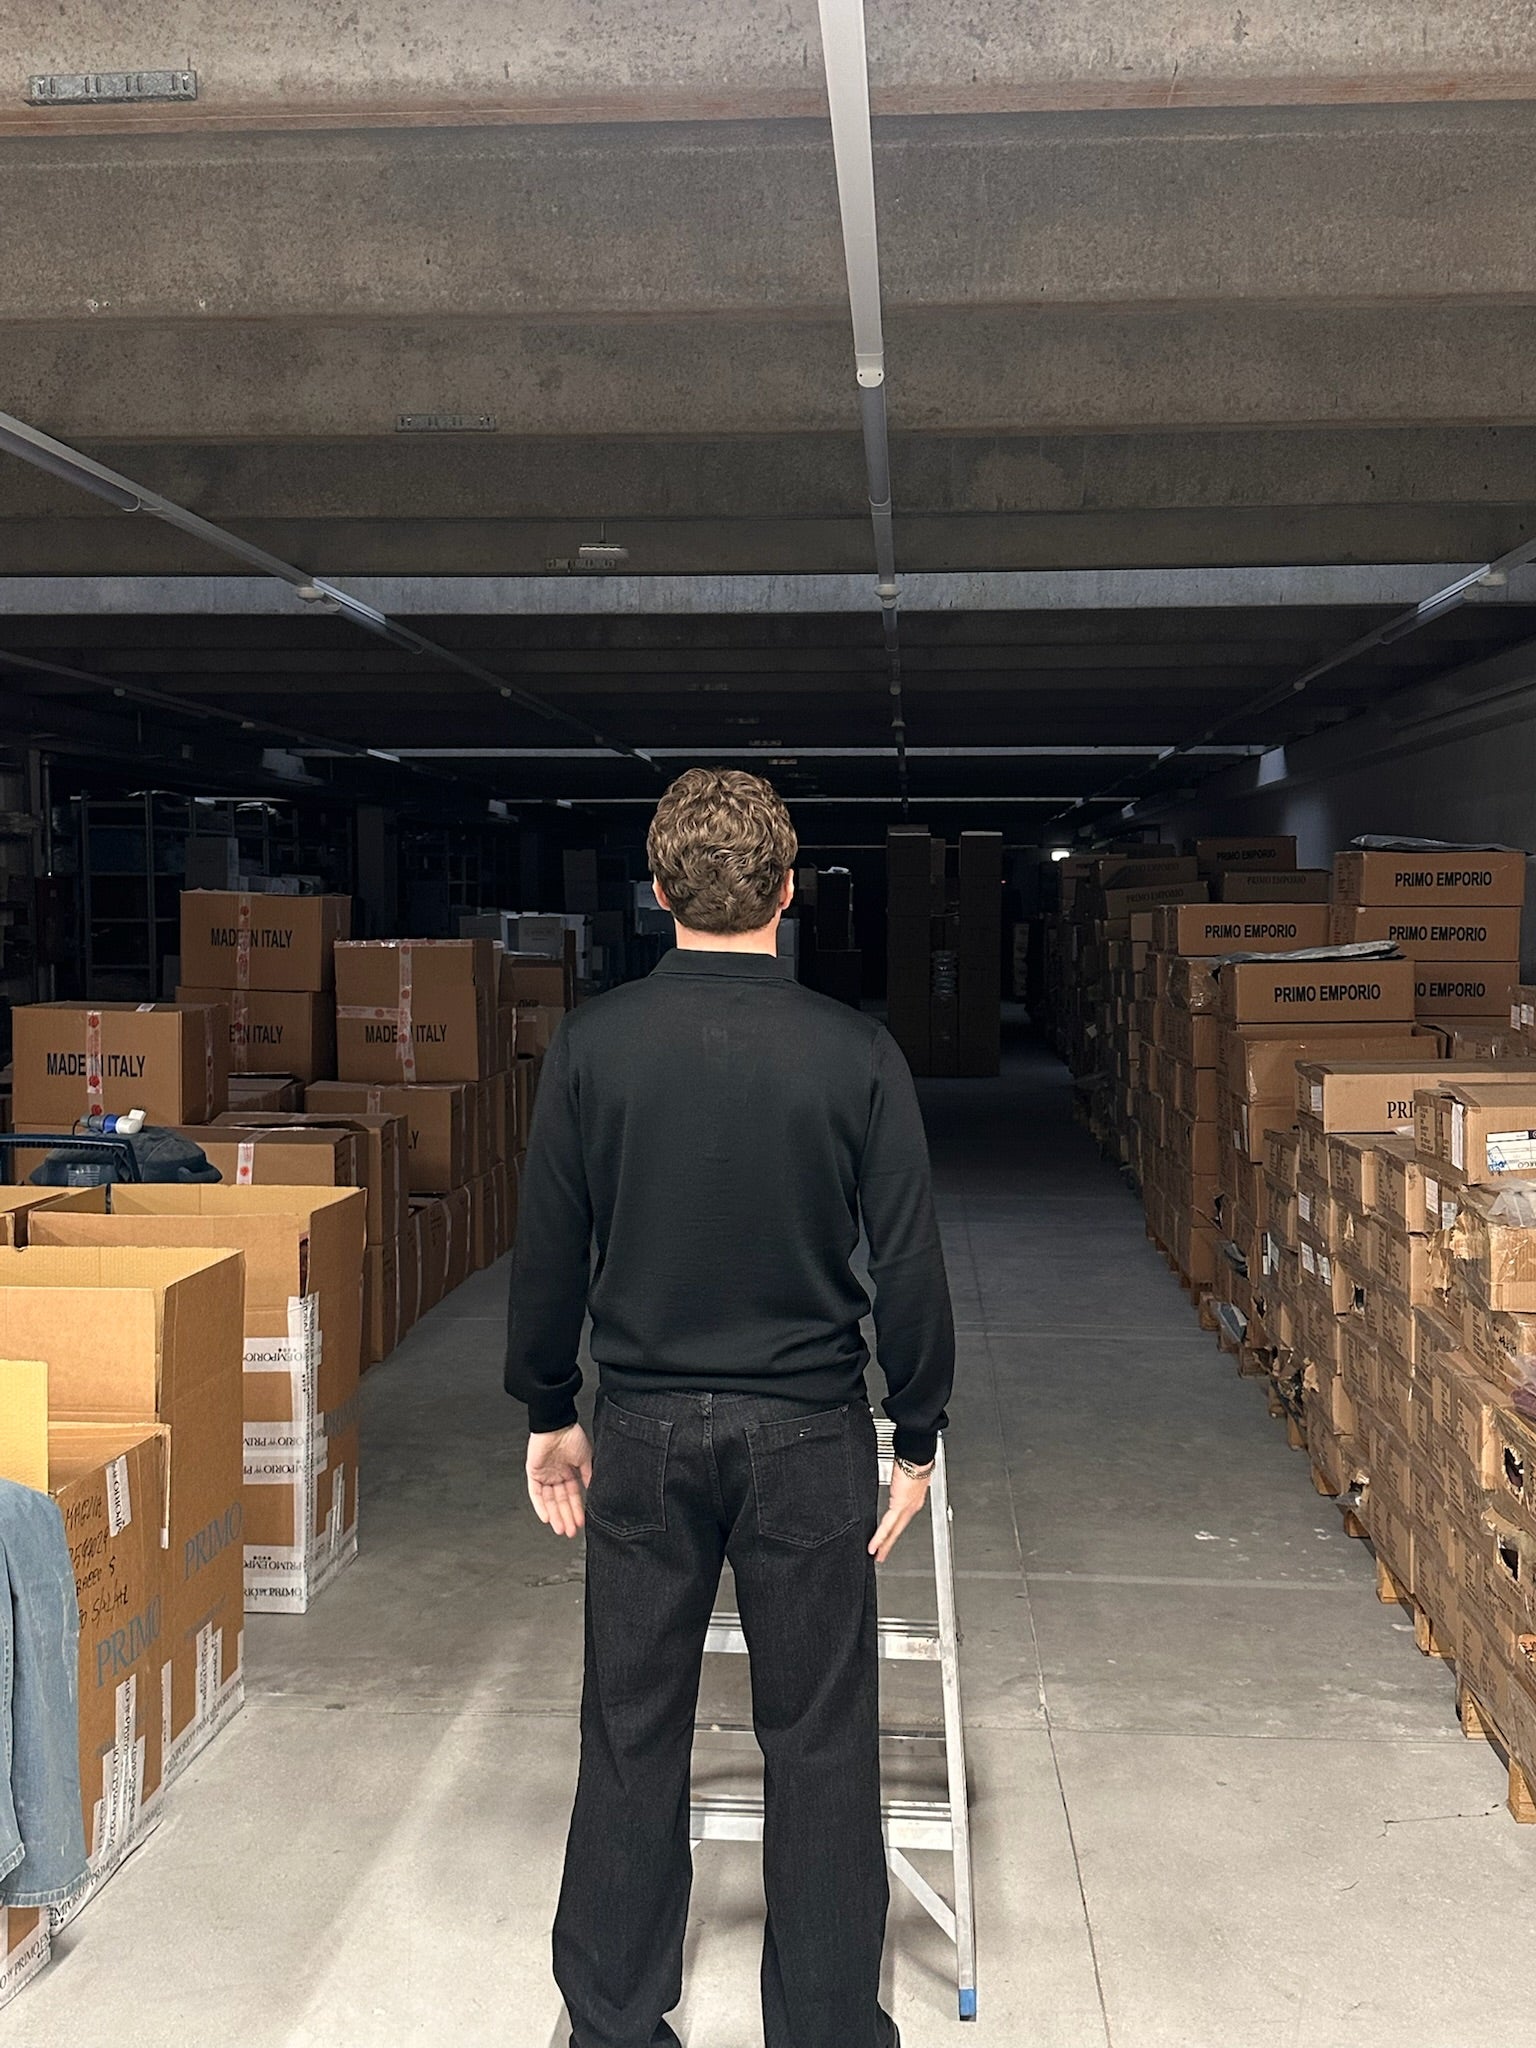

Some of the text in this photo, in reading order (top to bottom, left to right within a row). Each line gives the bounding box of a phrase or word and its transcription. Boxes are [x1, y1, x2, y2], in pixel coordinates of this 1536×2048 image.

[1394, 871, 1492, 887] PRIMO EMPORIO
[262, 929, 293, 948] ITALY
[1205, 924, 1297, 938] PRIMO EMPORIO
[1389, 926, 1487, 941] PRIMO EMPORIO
[1274, 984, 1381, 1002] PRIMO EMPORIO
[1430, 982, 1486, 997] EMPORIO
[253, 1025, 283, 1044] ITALY
[365, 1025, 397, 1043] MADE
[416, 1024, 447, 1042] ITALY
[47, 1053, 86, 1076] MADE
[108, 1055, 146, 1077] ITALY
[1387, 1101, 1414, 1119] PRI
[184, 1502, 243, 1582] PRIMO
[96, 1594, 162, 1689] PRIMO
